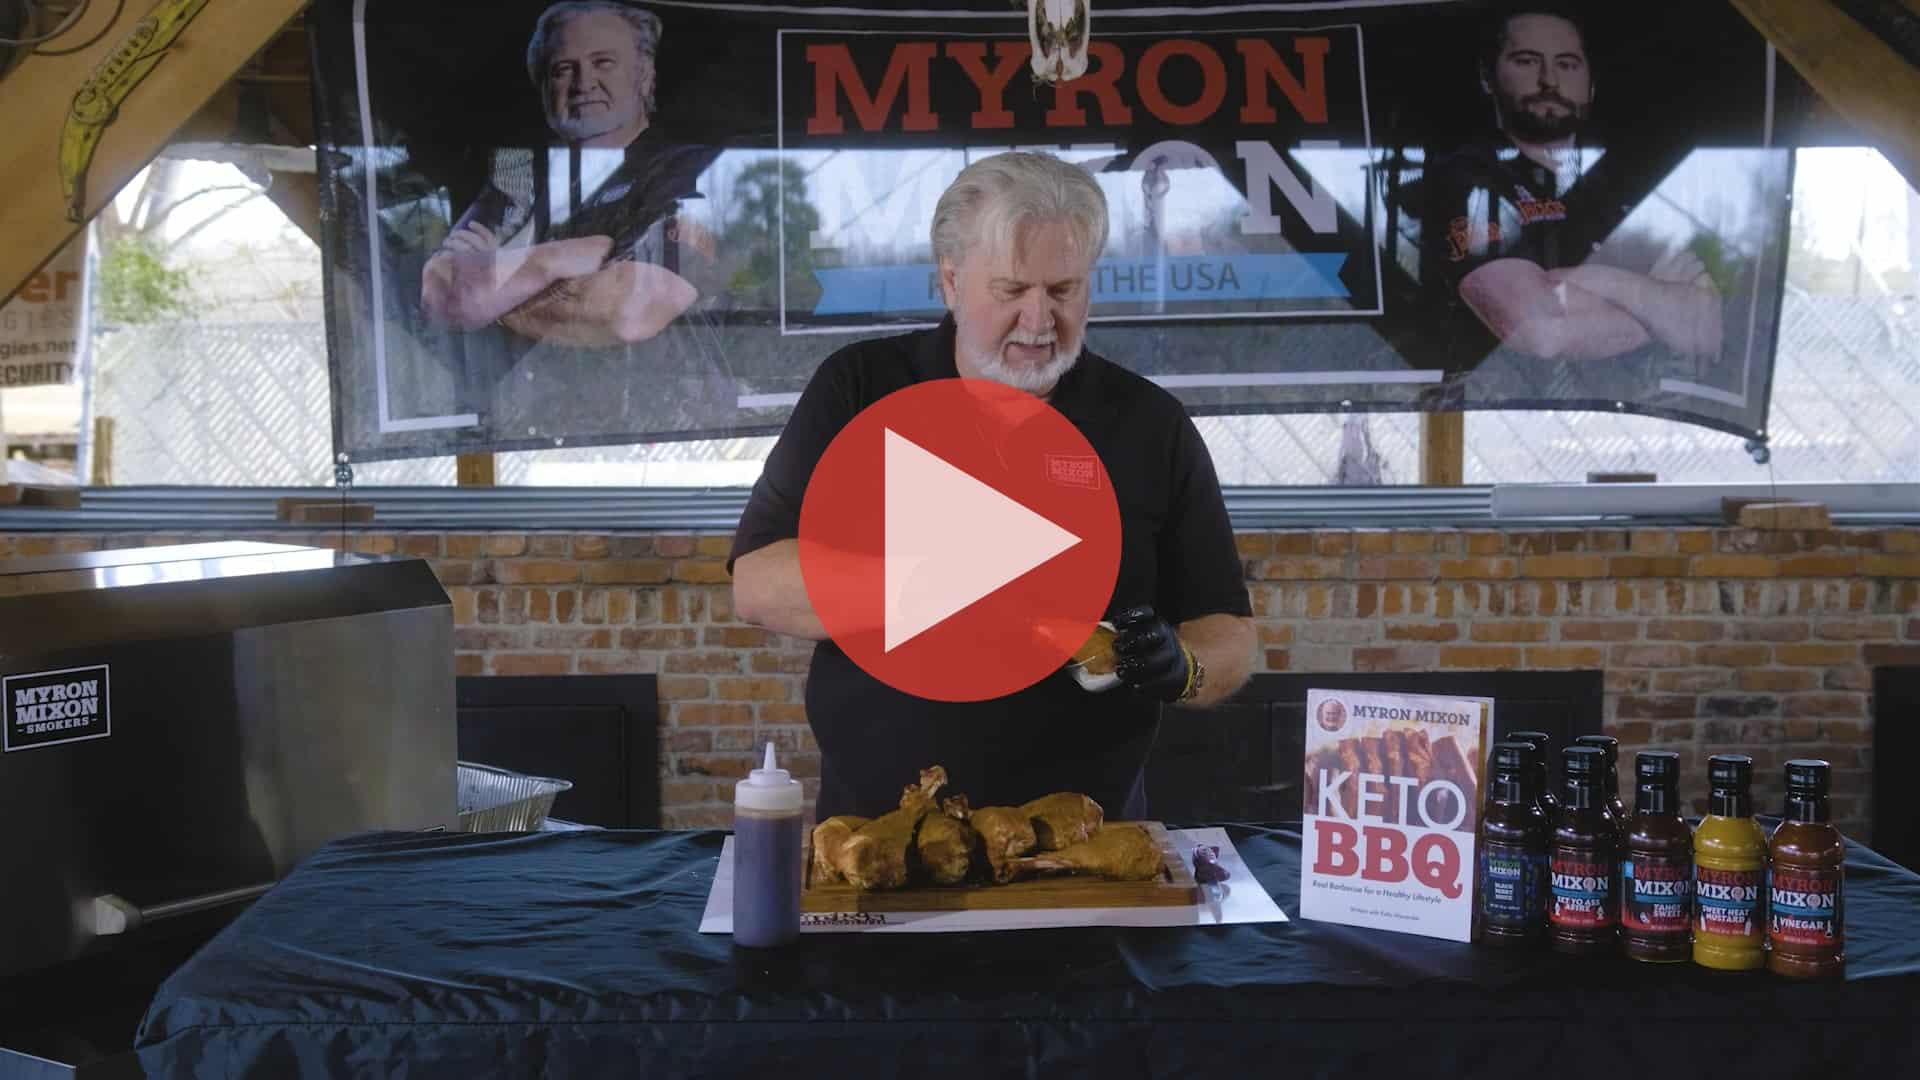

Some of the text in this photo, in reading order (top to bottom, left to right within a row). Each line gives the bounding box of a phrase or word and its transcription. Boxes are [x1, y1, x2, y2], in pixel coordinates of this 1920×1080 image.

[806, 37, 1331, 135] MYRON
[1090, 262, 1241, 294] THE USA
[15, 679, 98, 706] MYRON
[15, 697, 98, 725] MIXON
[1353, 705, 1471, 727] MYRON MIXON
[1318, 768, 1466, 832] KETO
[1312, 820, 1463, 900] BBQ
[1552, 872, 1608, 891] MIXON
[1696, 880, 1758, 901] MIXON
[1771, 888, 1835, 909] MIXON
[1780, 916, 1824, 931] VINEGAR
